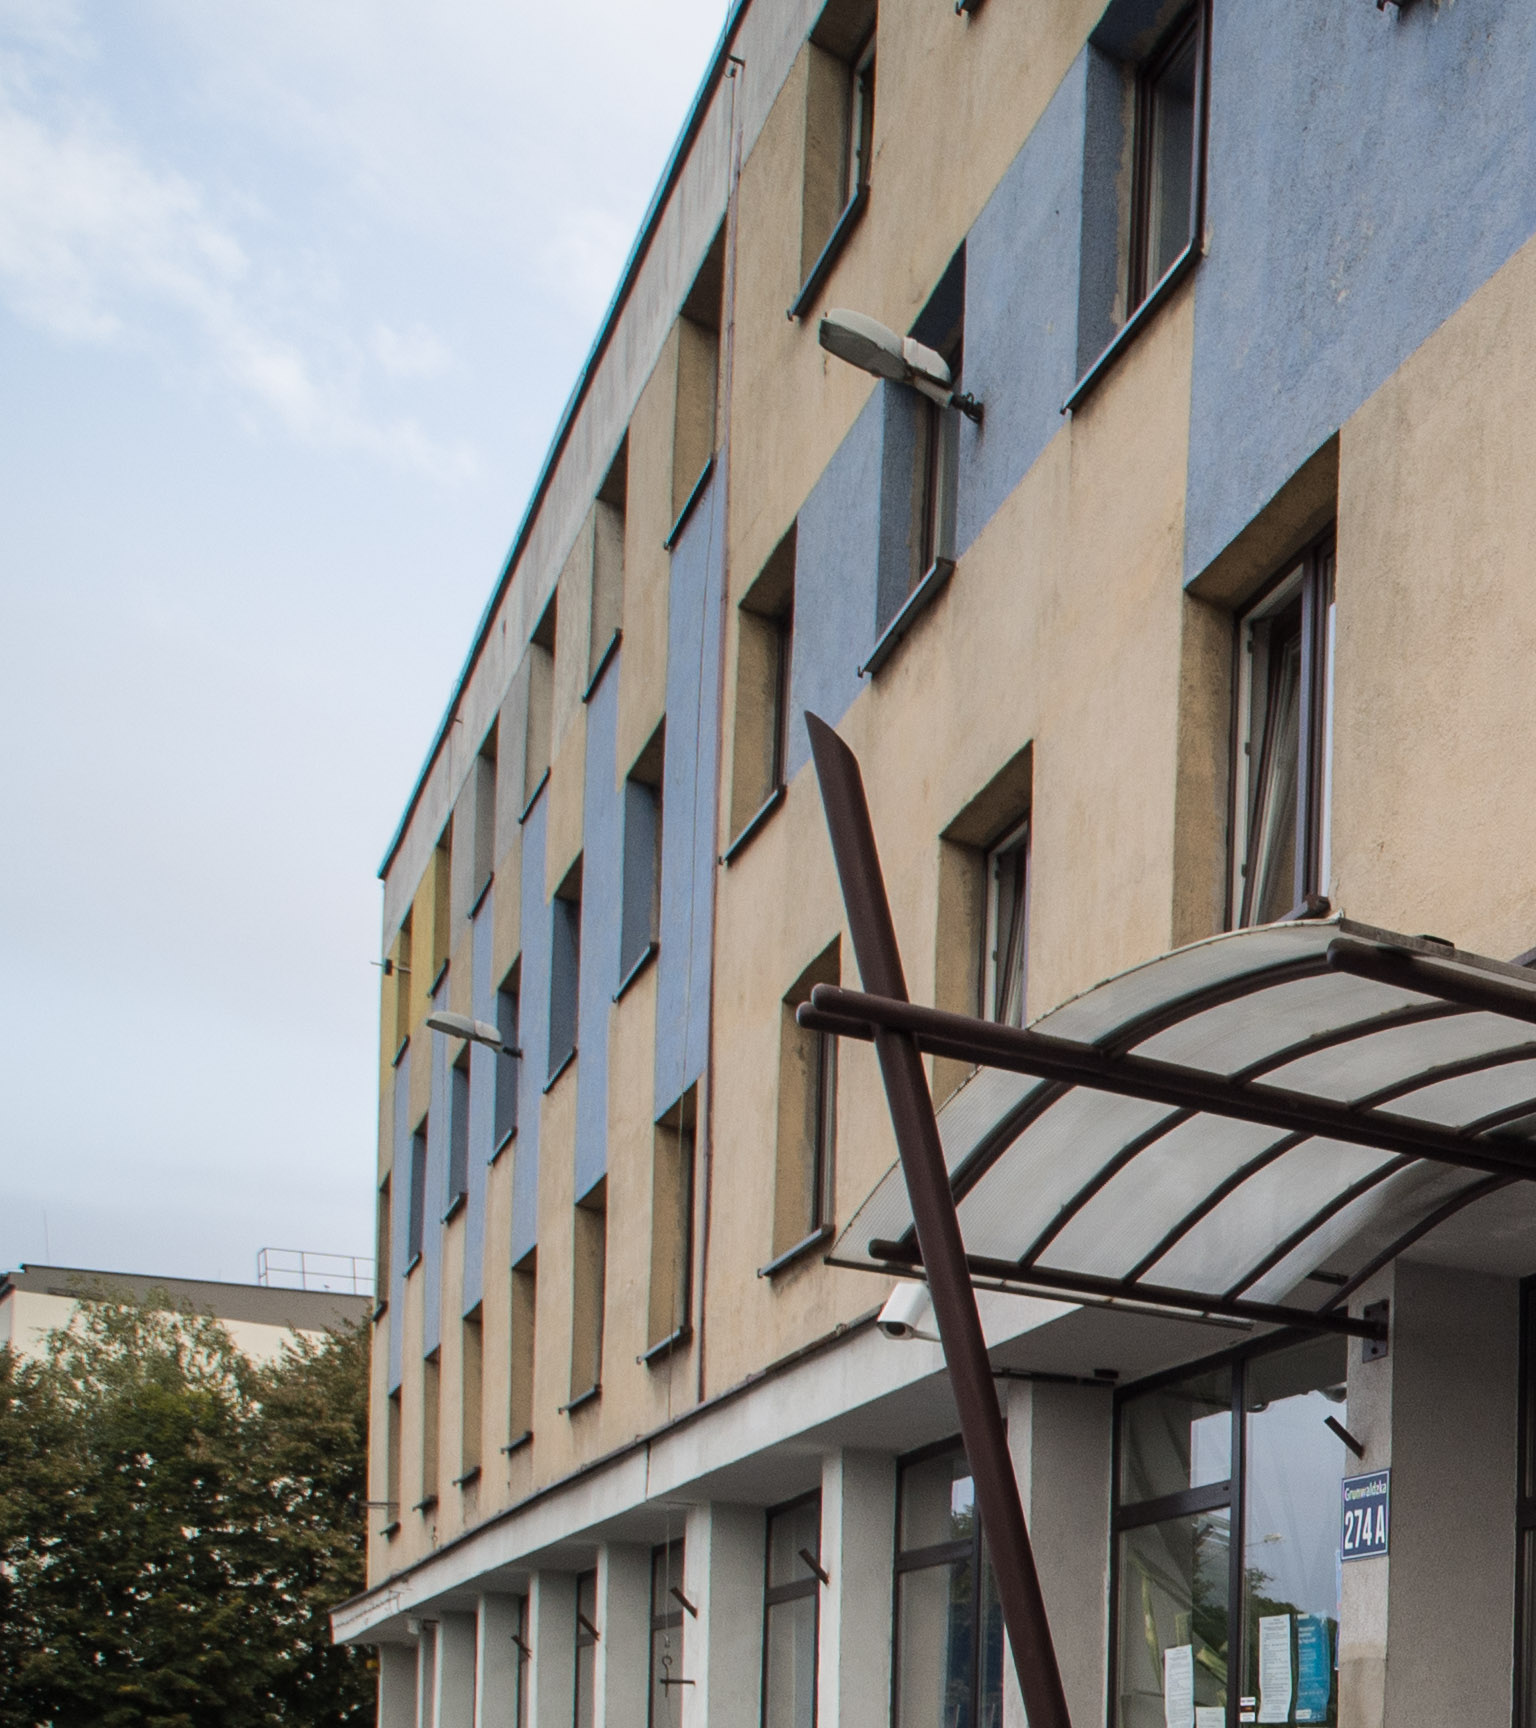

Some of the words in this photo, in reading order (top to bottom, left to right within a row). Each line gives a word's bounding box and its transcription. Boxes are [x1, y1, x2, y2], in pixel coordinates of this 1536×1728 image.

[1344, 1480, 1387, 1501] Grunwaldzka
[1344, 1507, 1373, 1551] 274
[1375, 1504, 1386, 1545] A
